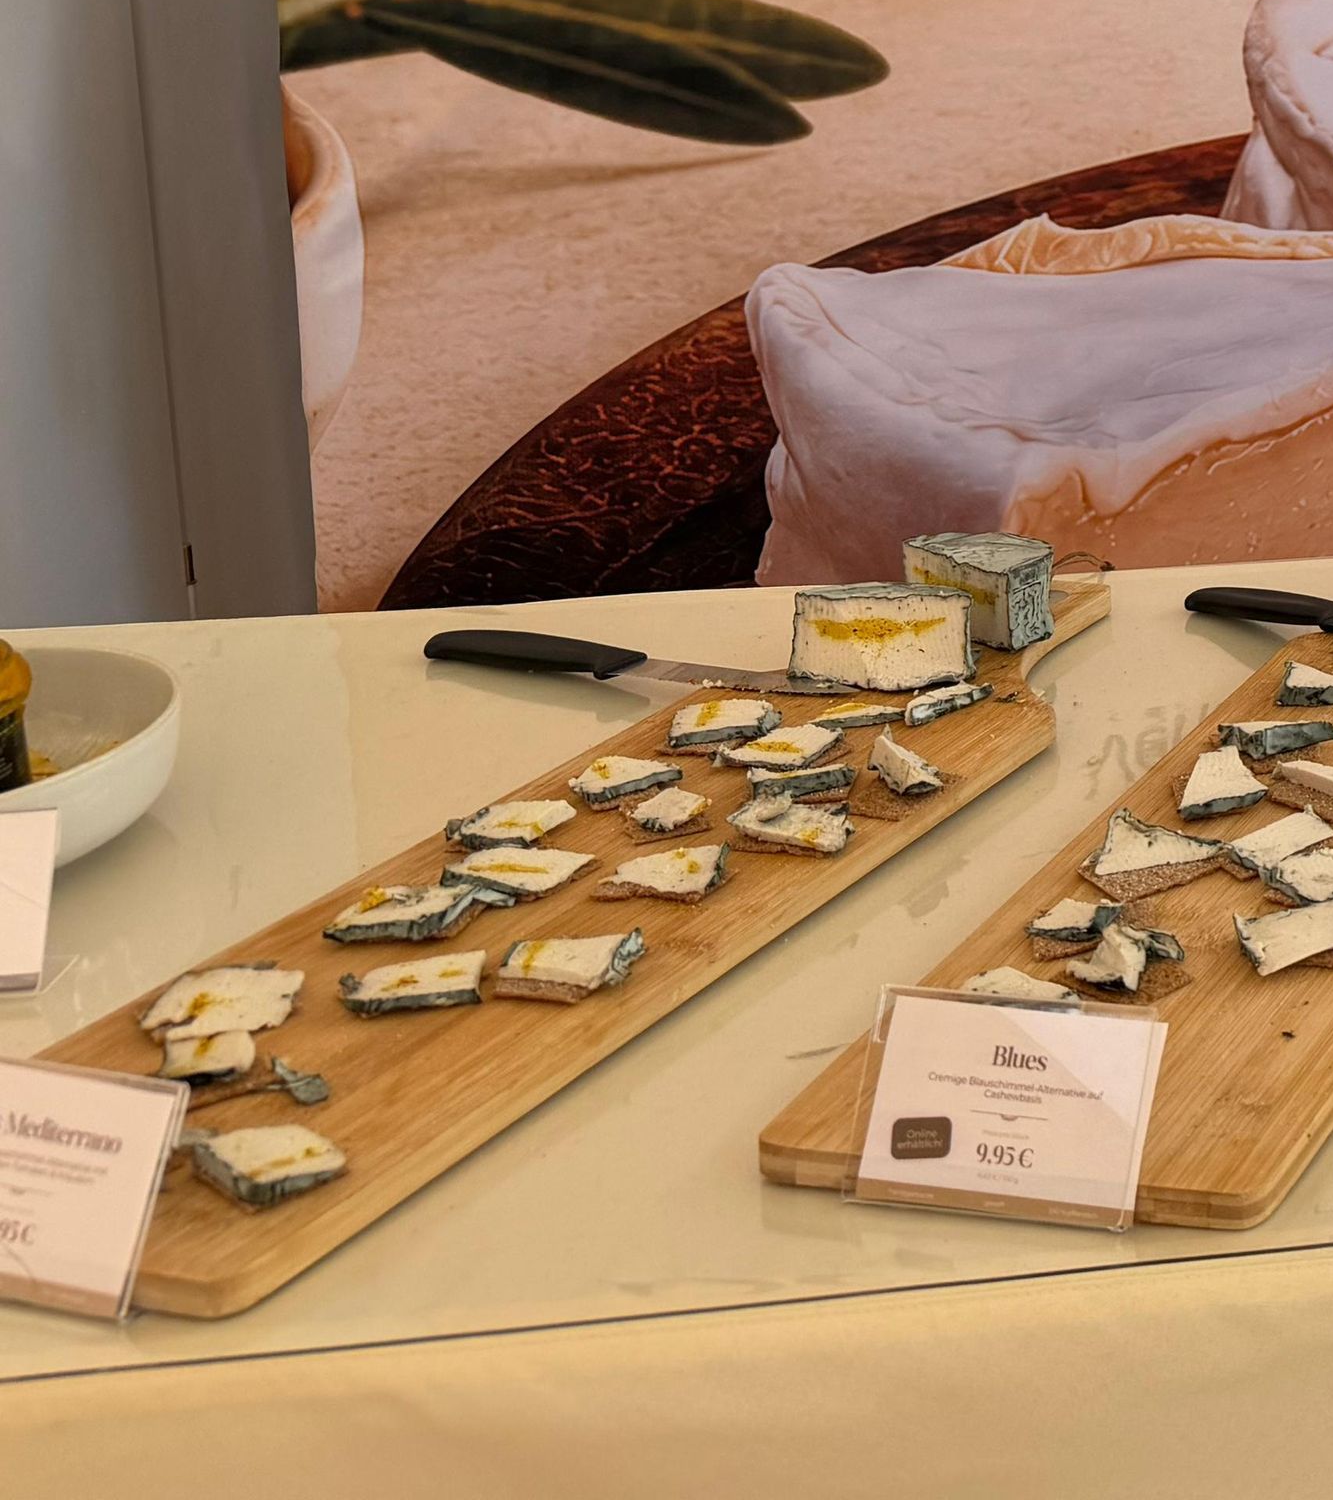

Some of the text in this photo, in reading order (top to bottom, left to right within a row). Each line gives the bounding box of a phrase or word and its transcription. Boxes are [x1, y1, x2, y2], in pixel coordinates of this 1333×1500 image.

[991, 1045, 1049, 1071] Blues
[928, 1071, 967, 1085] Cremige
[906, 1129, 938, 1138] Online
[1019, 1147, 1034, 1169] €
